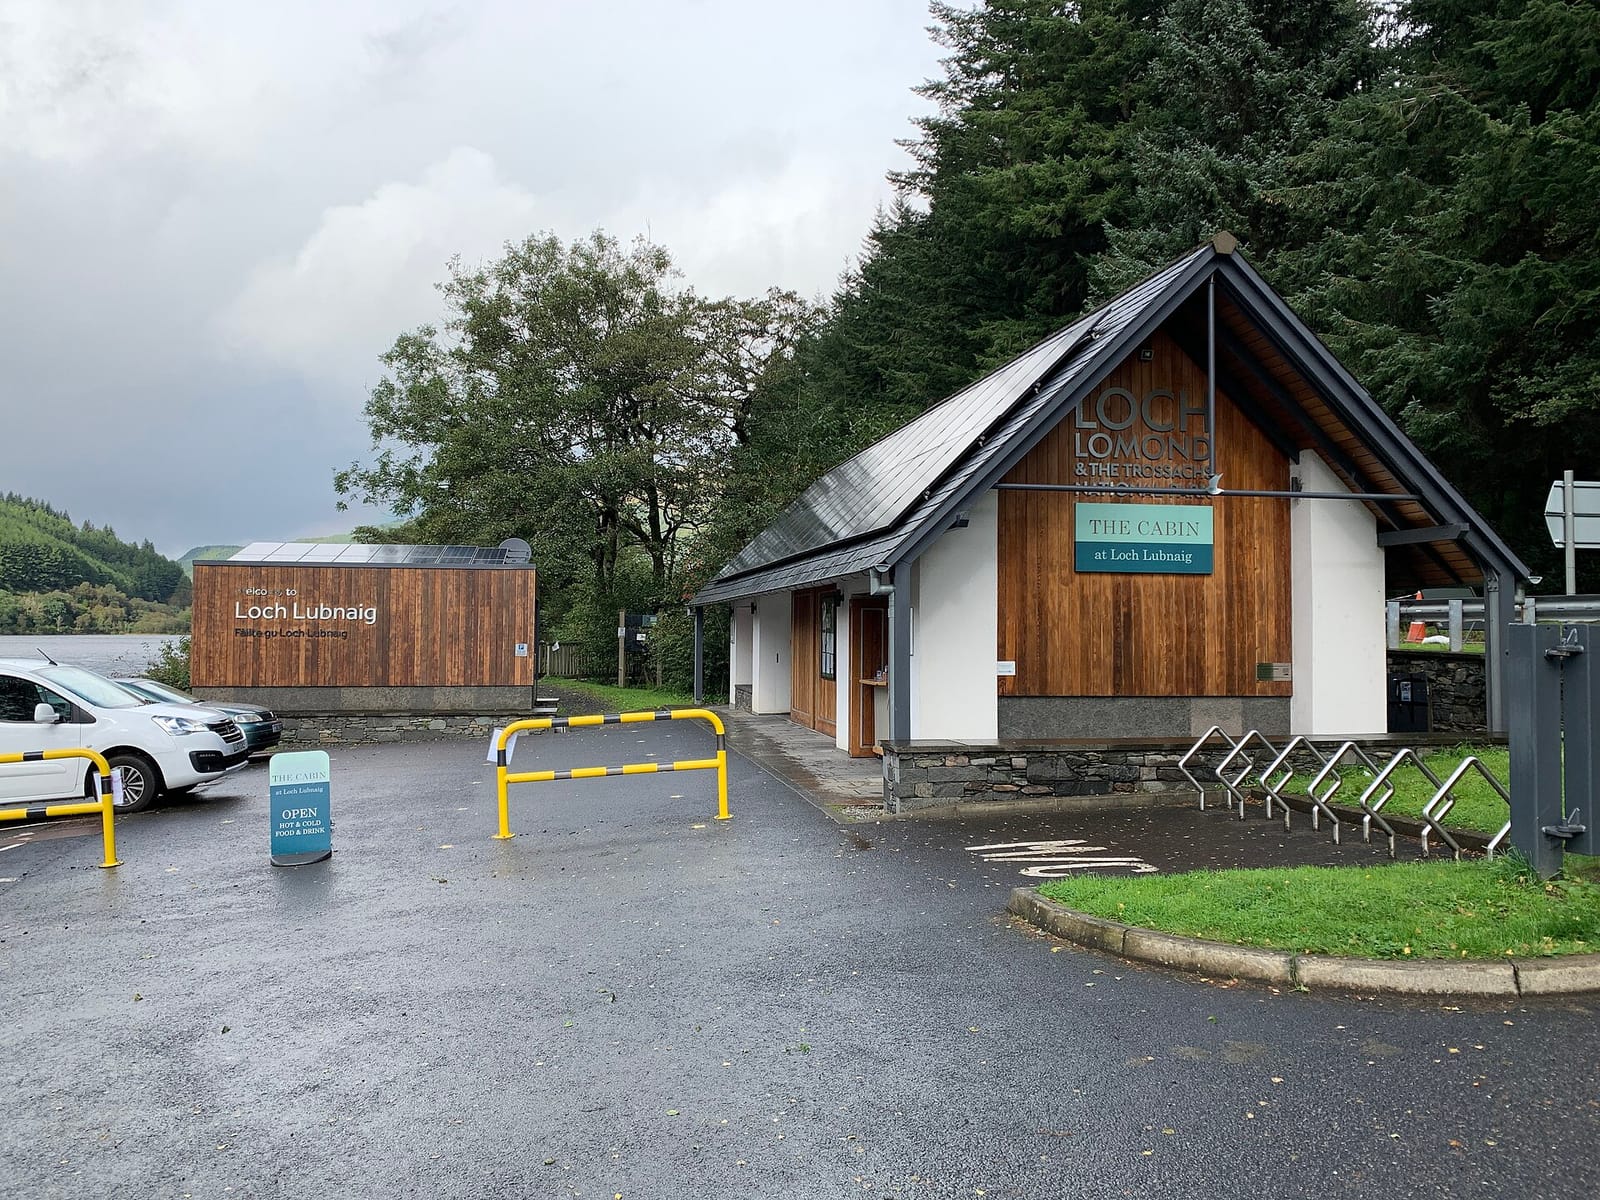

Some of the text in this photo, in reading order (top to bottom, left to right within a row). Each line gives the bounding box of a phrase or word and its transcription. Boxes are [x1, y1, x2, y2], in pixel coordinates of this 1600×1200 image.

[1075, 387, 1211, 432] LOCH
[1075, 432, 1211, 461] LOMOND
[1075, 462, 1088, 476] &
[1089, 462, 1119, 477] THE
[1089, 519, 1200, 536] THE CABIN
[1094, 548, 1193, 564] at Loch Lubnaig
[286, 588, 297, 596] to
[235, 601, 377, 625] Loch Lubnaig
[280, 628, 304, 638] Loch
[307, 628, 347, 639] Lubnaig
[272, 771, 326, 783] THE CABIN
[282, 808, 318, 819] OPEN
[302, 827, 325, 835] DRINK
